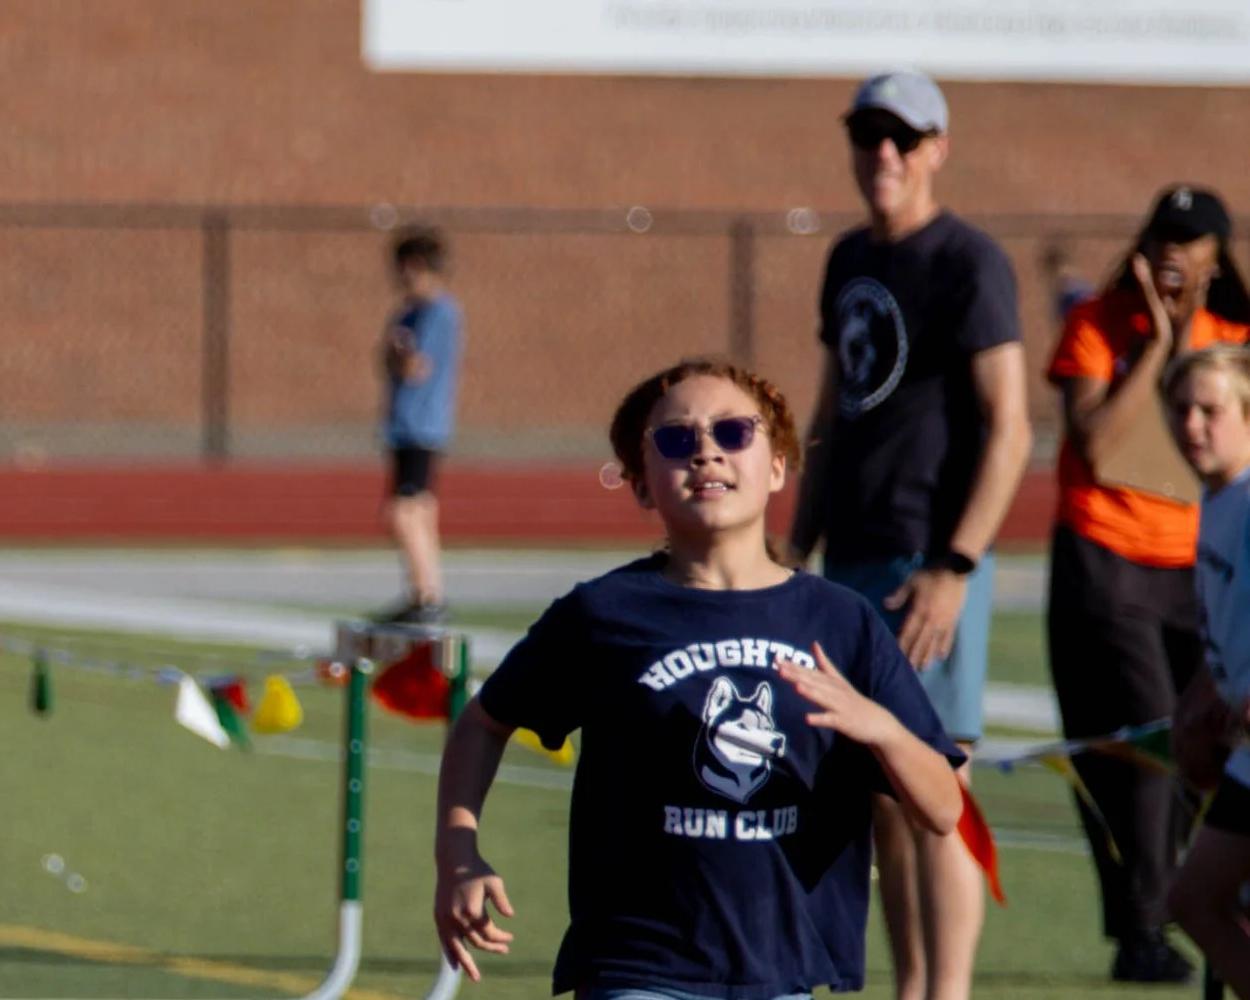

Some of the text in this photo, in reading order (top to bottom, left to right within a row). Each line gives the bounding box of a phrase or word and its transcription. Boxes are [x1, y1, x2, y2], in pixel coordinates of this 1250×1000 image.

[638, 637, 818, 692] HOUGHTO
[664, 805, 798, 841] RUN CLUB
